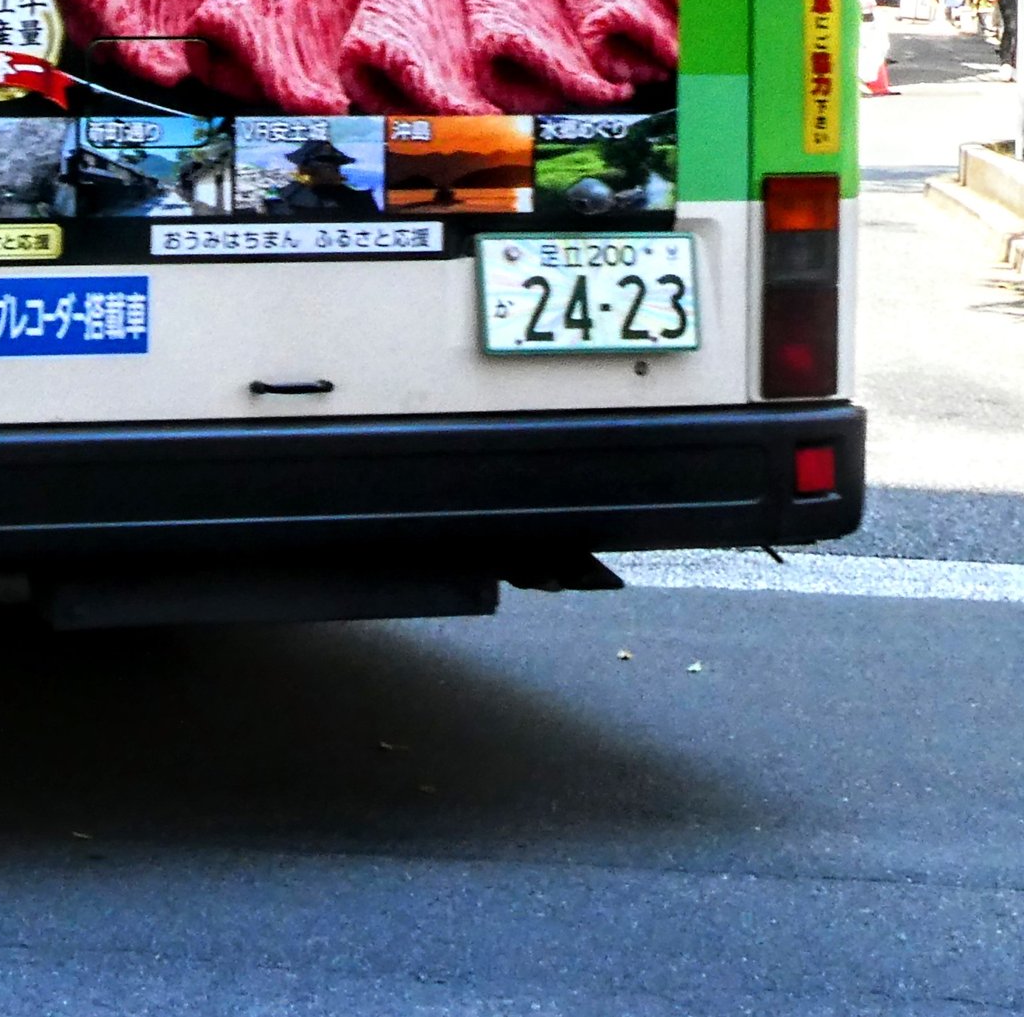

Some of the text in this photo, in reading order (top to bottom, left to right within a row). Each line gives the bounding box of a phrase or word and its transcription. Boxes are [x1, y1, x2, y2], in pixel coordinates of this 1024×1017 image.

[163, 227, 430, 250] おうみはちまん ふるさと応援
